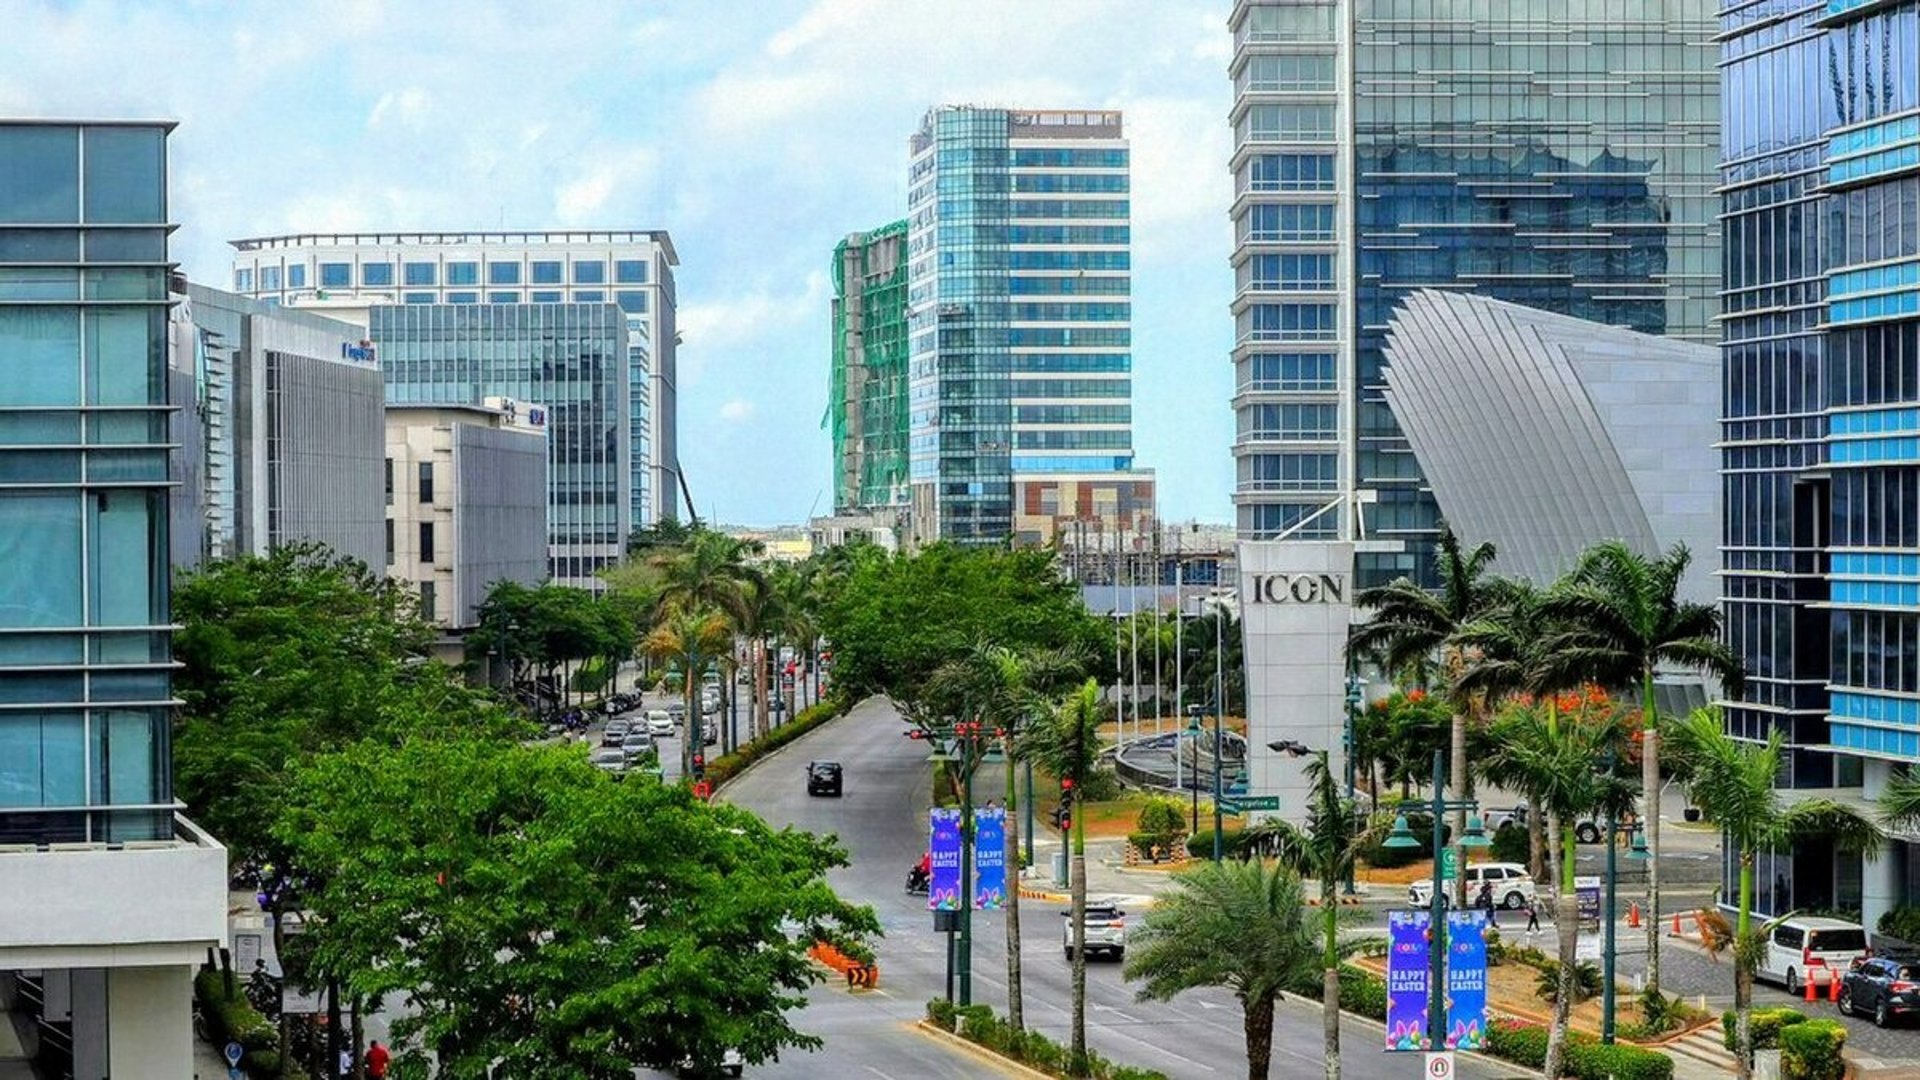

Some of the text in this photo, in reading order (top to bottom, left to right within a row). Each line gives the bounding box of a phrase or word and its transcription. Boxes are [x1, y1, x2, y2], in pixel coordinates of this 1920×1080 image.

[1252, 573, 1344, 604] ICON
[1391, 970, 1425, 980] HAPPY
[1450, 969, 1483, 980] HAPPY
[1391, 981, 1425, 991] EASTER
[1450, 980, 1483, 991] EASTER
